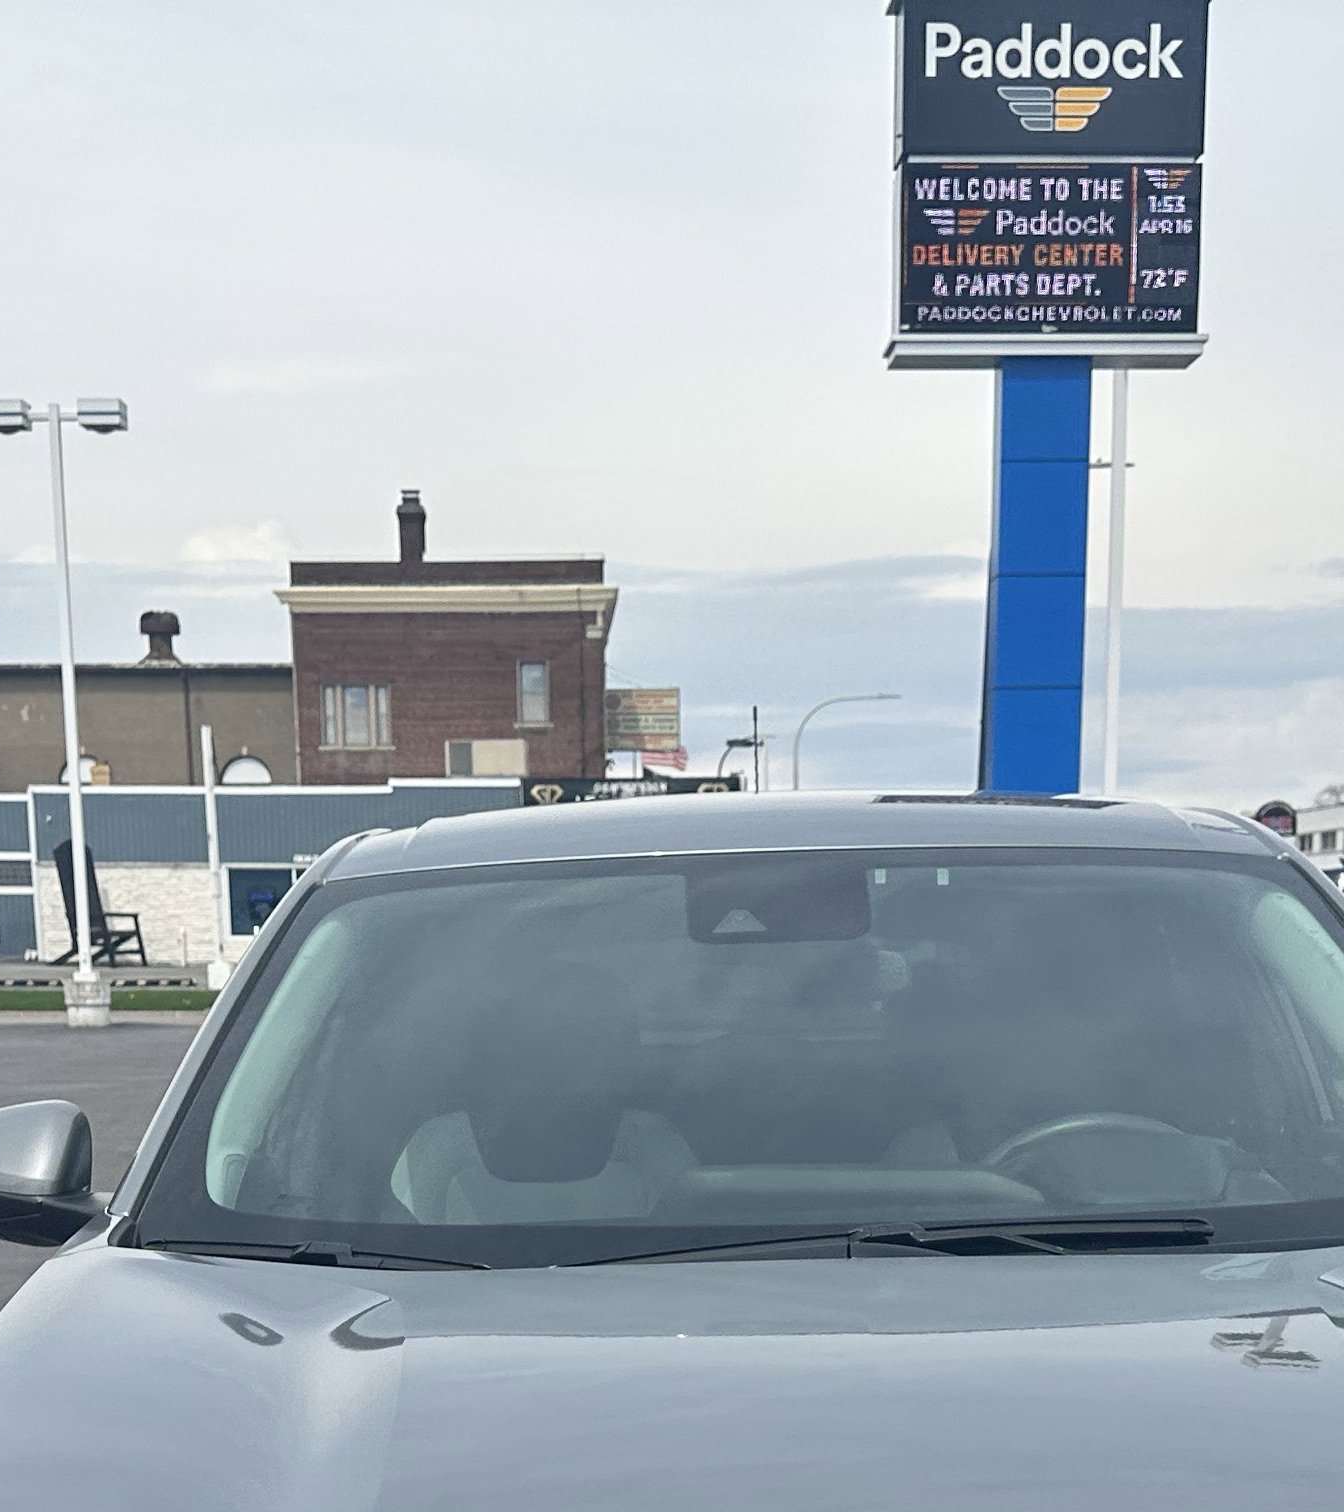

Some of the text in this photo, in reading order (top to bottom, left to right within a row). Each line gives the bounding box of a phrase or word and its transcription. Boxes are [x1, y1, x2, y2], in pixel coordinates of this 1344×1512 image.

[925, 22, 1184, 79] Paddock
[914, 177, 1125, 201] WELCOME TO THE
[1147, 195, 1187, 213] 1:53
[995, 208, 1116, 236] Paddock
[911, 243, 1124, 267] DELIVERY CENTER
[932, 273, 1102, 297] & PARTS DEPT.
